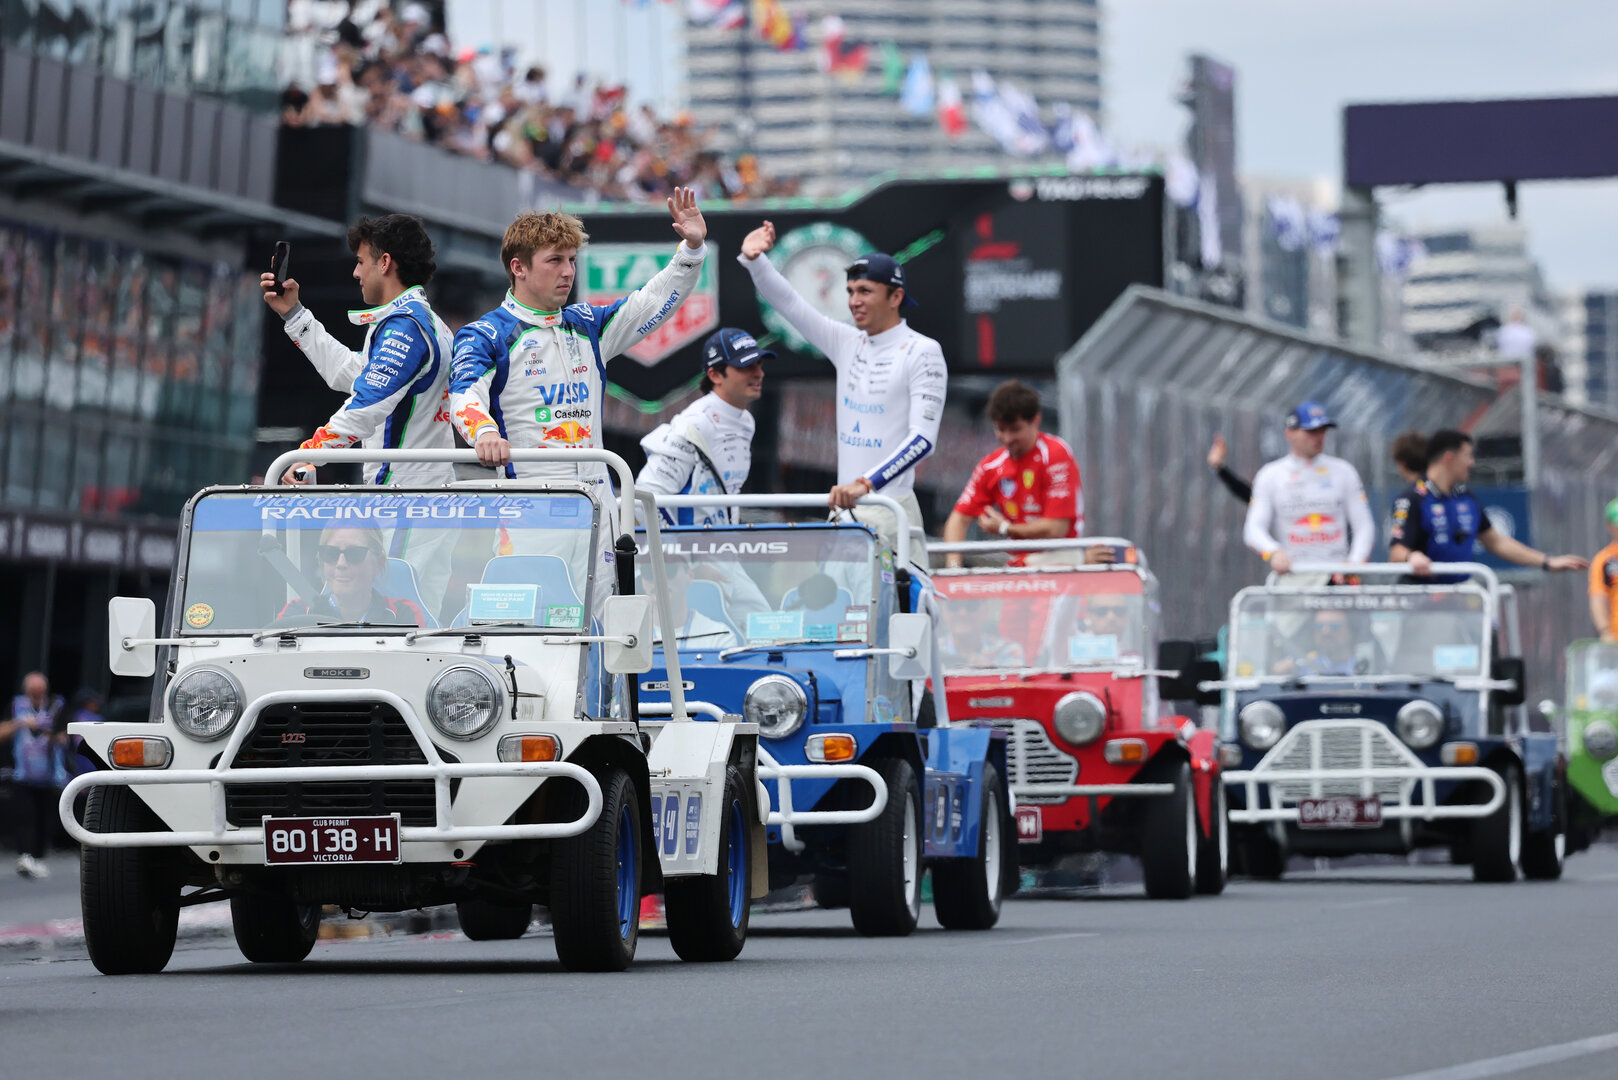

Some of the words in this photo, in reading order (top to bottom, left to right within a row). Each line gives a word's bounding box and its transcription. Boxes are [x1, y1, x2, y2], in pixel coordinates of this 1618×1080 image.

[392, 293, 415, 308] VISA
[637, 312, 663, 335] THAT'S
[661, 289, 680, 318] MONEY
[525, 368, 547, 377] Mobil
[253, 494, 358, 507] Victorian
[366, 494, 419, 508] Mini
[427, 494, 482, 508] Club
[261, 506, 398, 520] RACING
[405, 506, 523, 519] BULLS
[948, 579, 1058, 594] FERRARI
[281, 733, 306, 743] 1275
